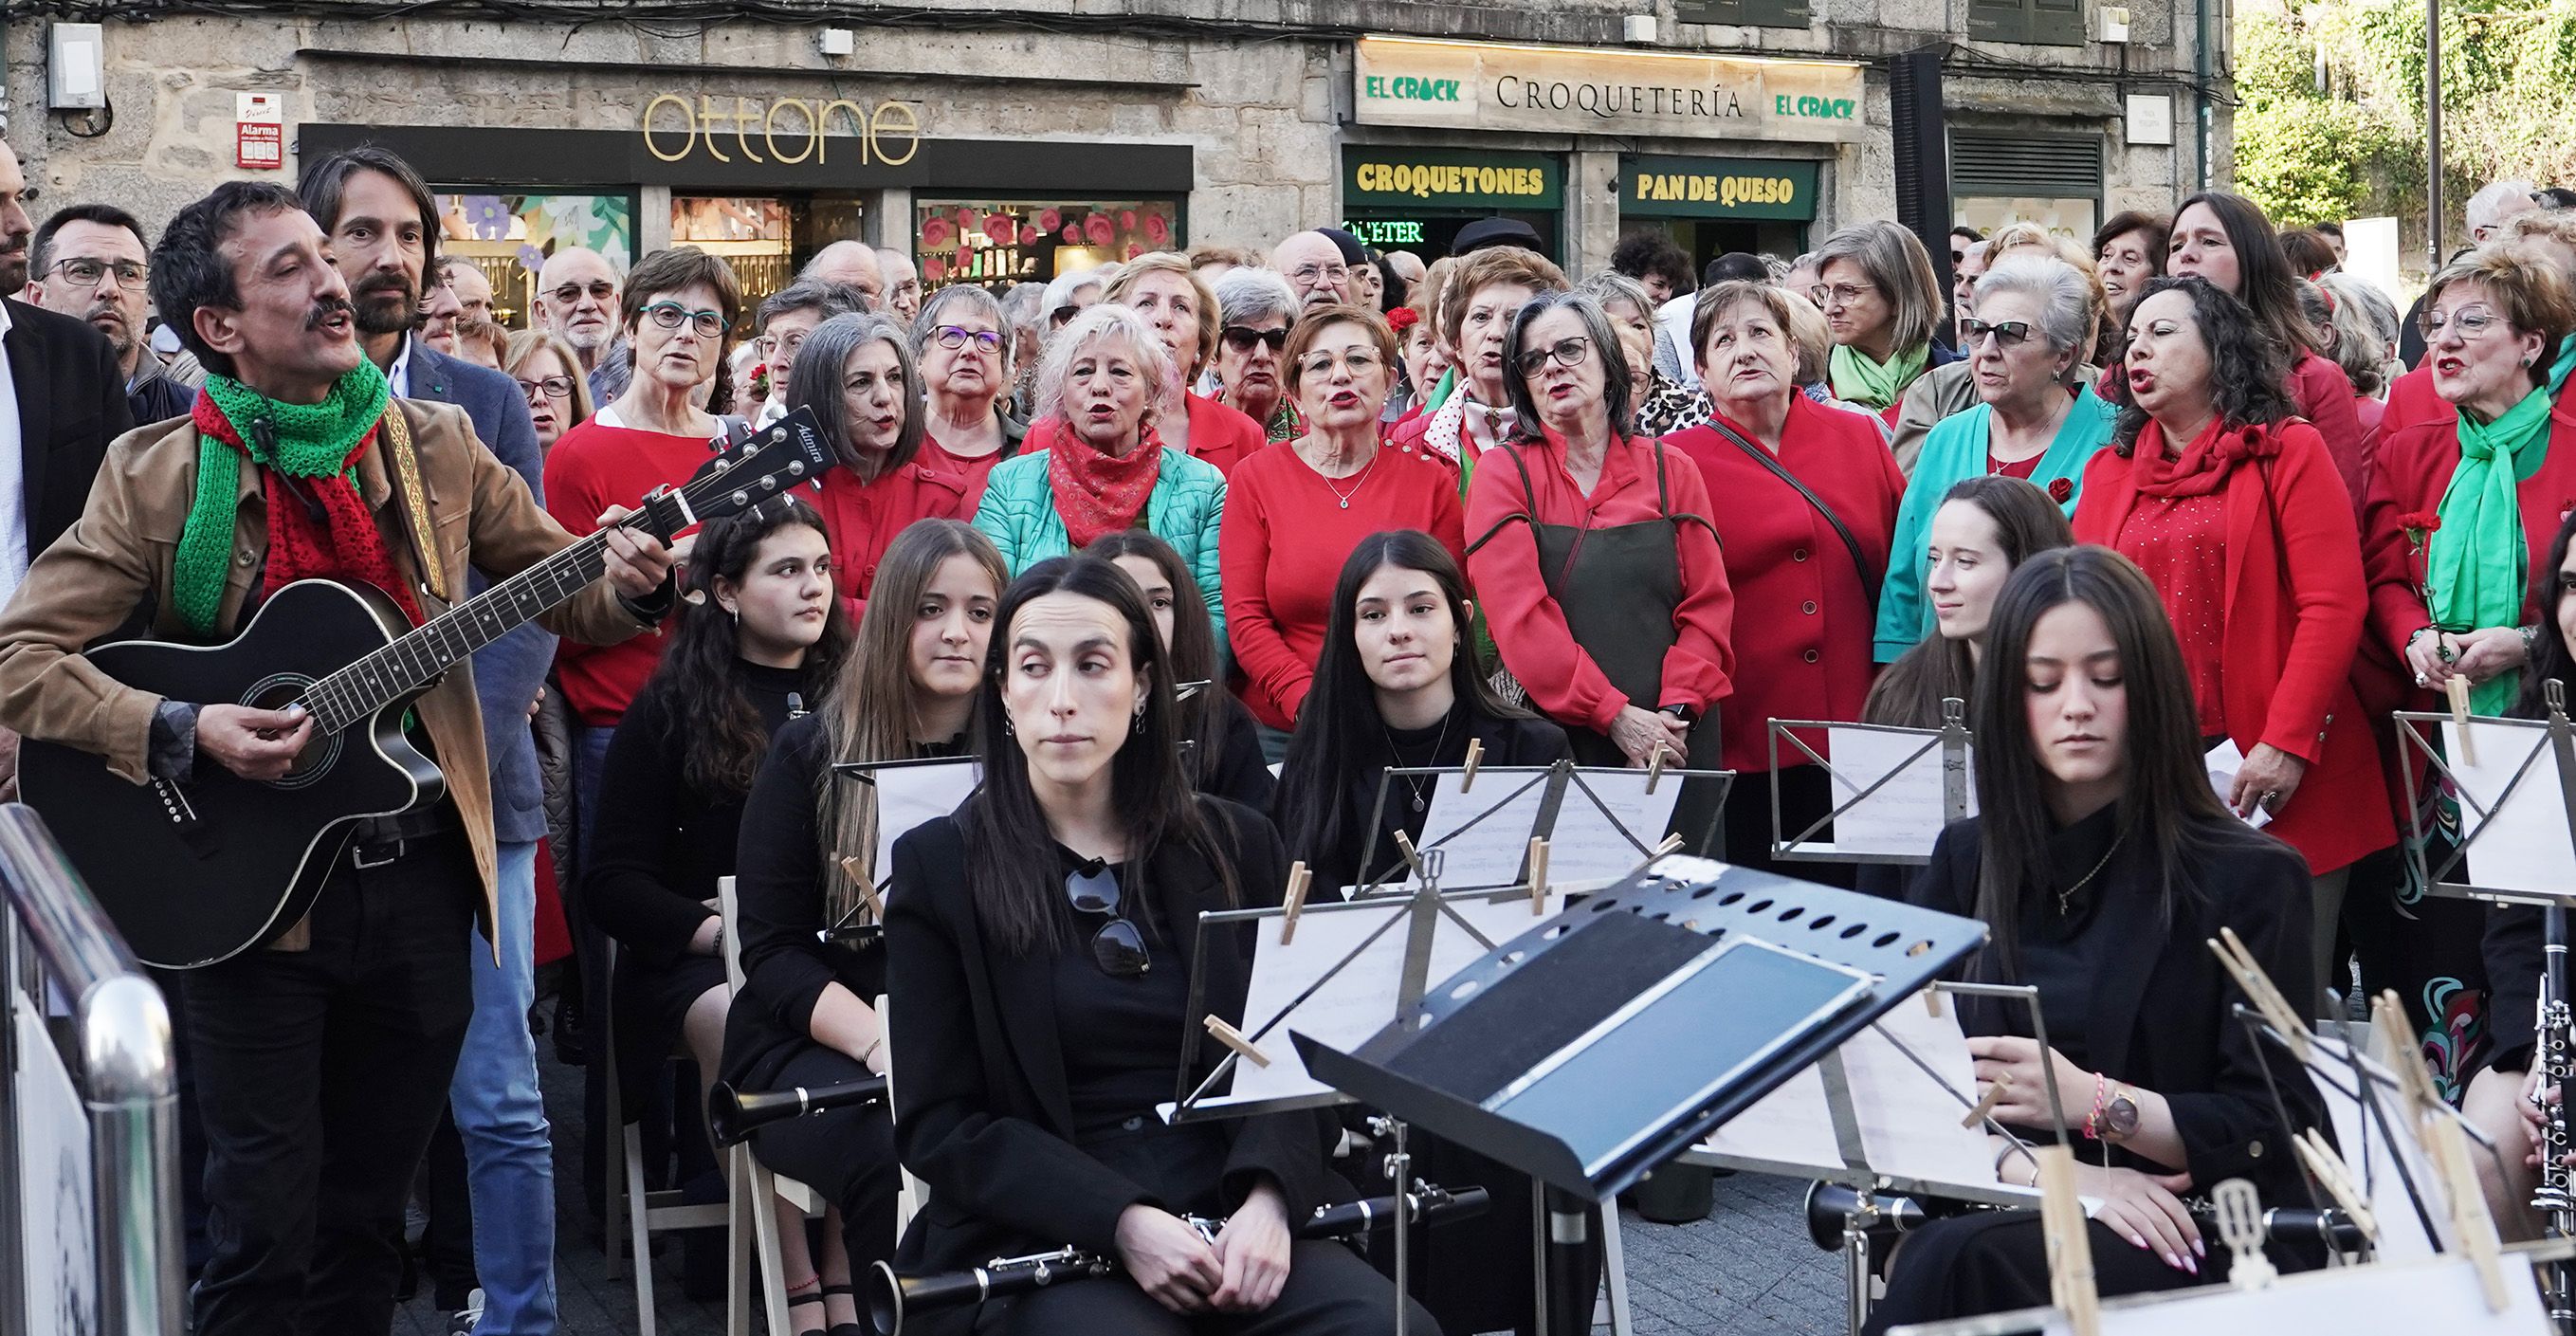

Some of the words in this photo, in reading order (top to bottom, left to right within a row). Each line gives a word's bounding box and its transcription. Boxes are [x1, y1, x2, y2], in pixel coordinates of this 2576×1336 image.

[1365, 76, 1390, 99] EL
[1392, 76, 1461, 102] CRACK
[1496, 75, 1744, 119] CROQUETERÍA
[1775, 94, 1796, 117] EL
[1798, 96, 1856, 120] CRACK
[241, 124, 279, 136] Alarma
[644, 94, 919, 166] ottone
[1357, 163, 1544, 198] CROQUETONES
[1636, 174, 1686, 201] PAN
[1688, 175, 1717, 202] DE
[1720, 176, 1794, 208] QUESO
[795, 422, 823, 463] Admira
